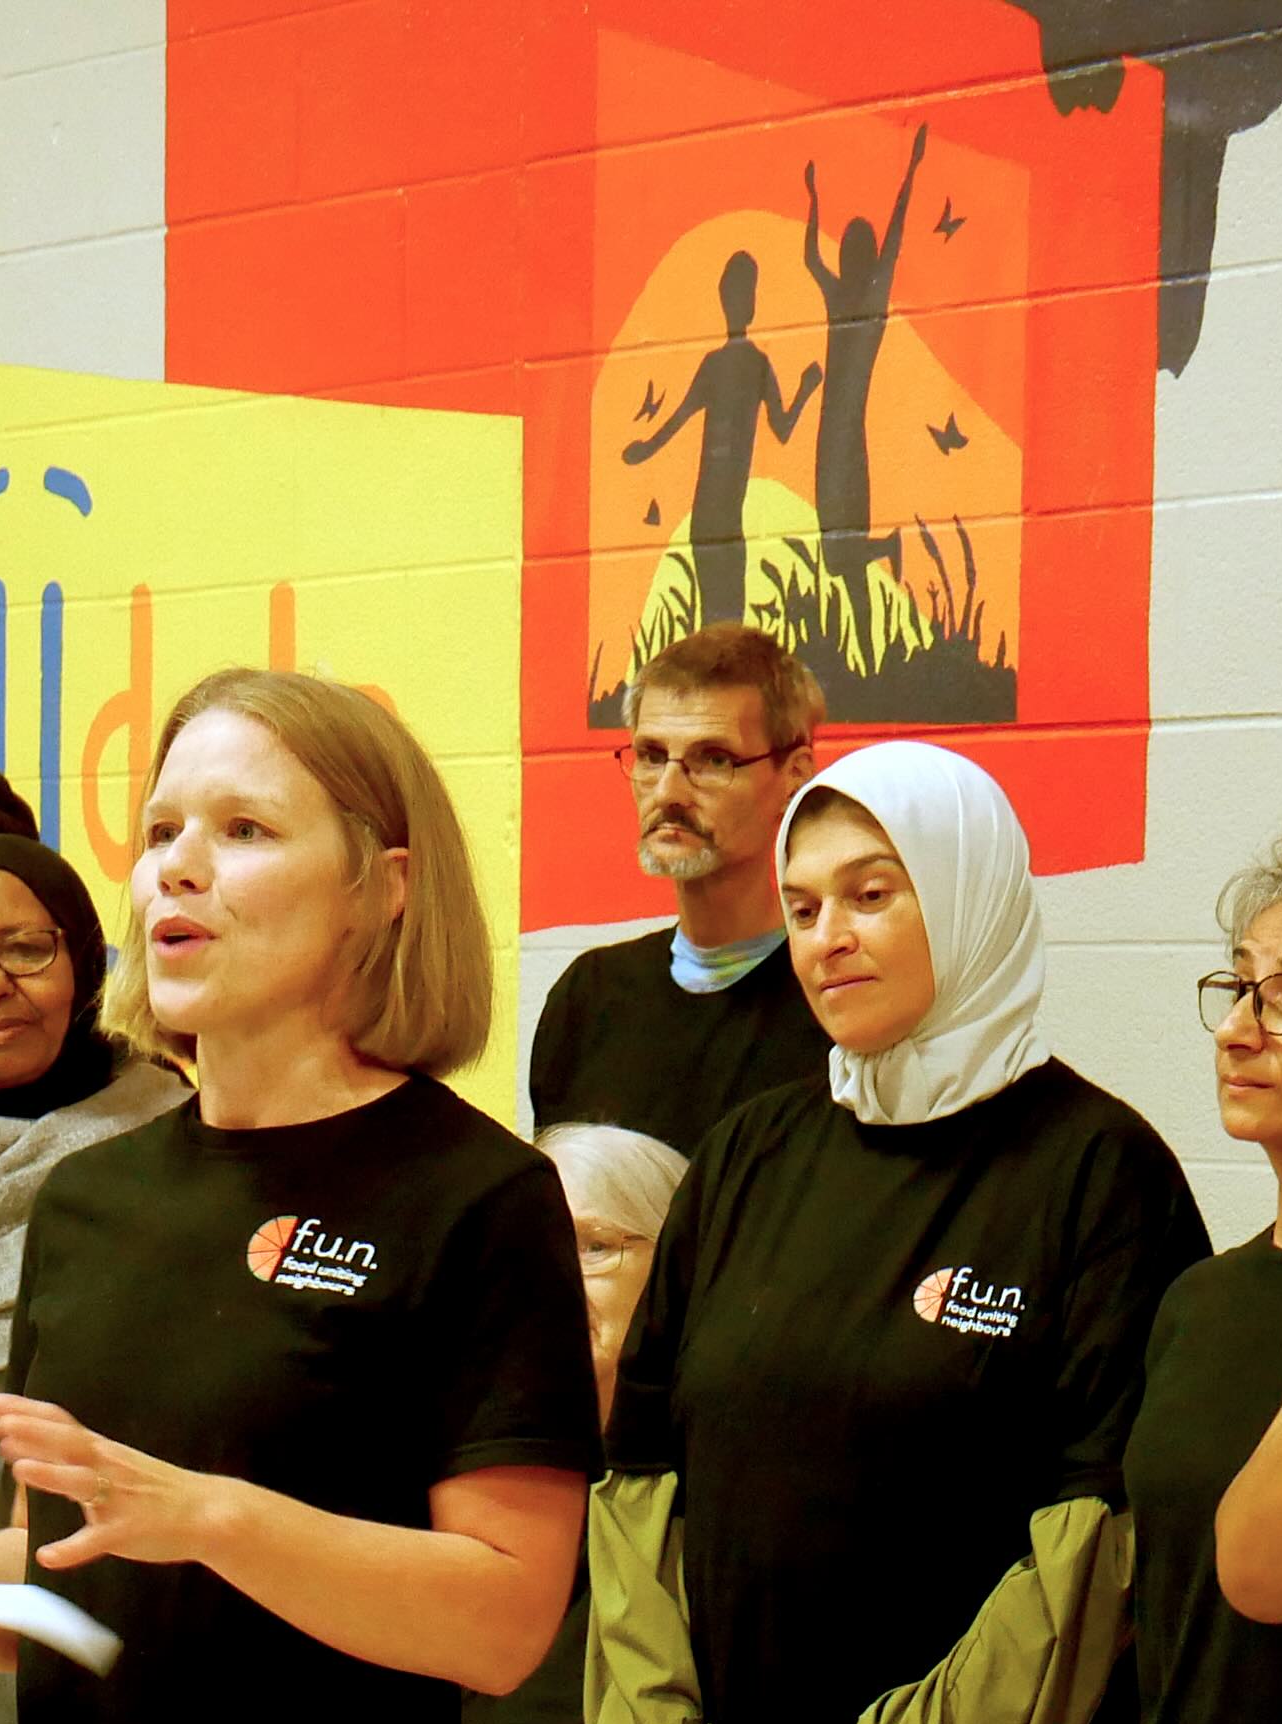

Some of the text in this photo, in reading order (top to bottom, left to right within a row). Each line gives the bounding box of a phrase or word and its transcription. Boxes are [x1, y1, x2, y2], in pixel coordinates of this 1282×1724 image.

[291, 1218, 378, 1270] f.u.n.
[950, 1266, 1026, 1311] f.u.n.
[941, 1315, 1012, 1337] neighbours
[945, 1300, 1019, 1328] food uniting
